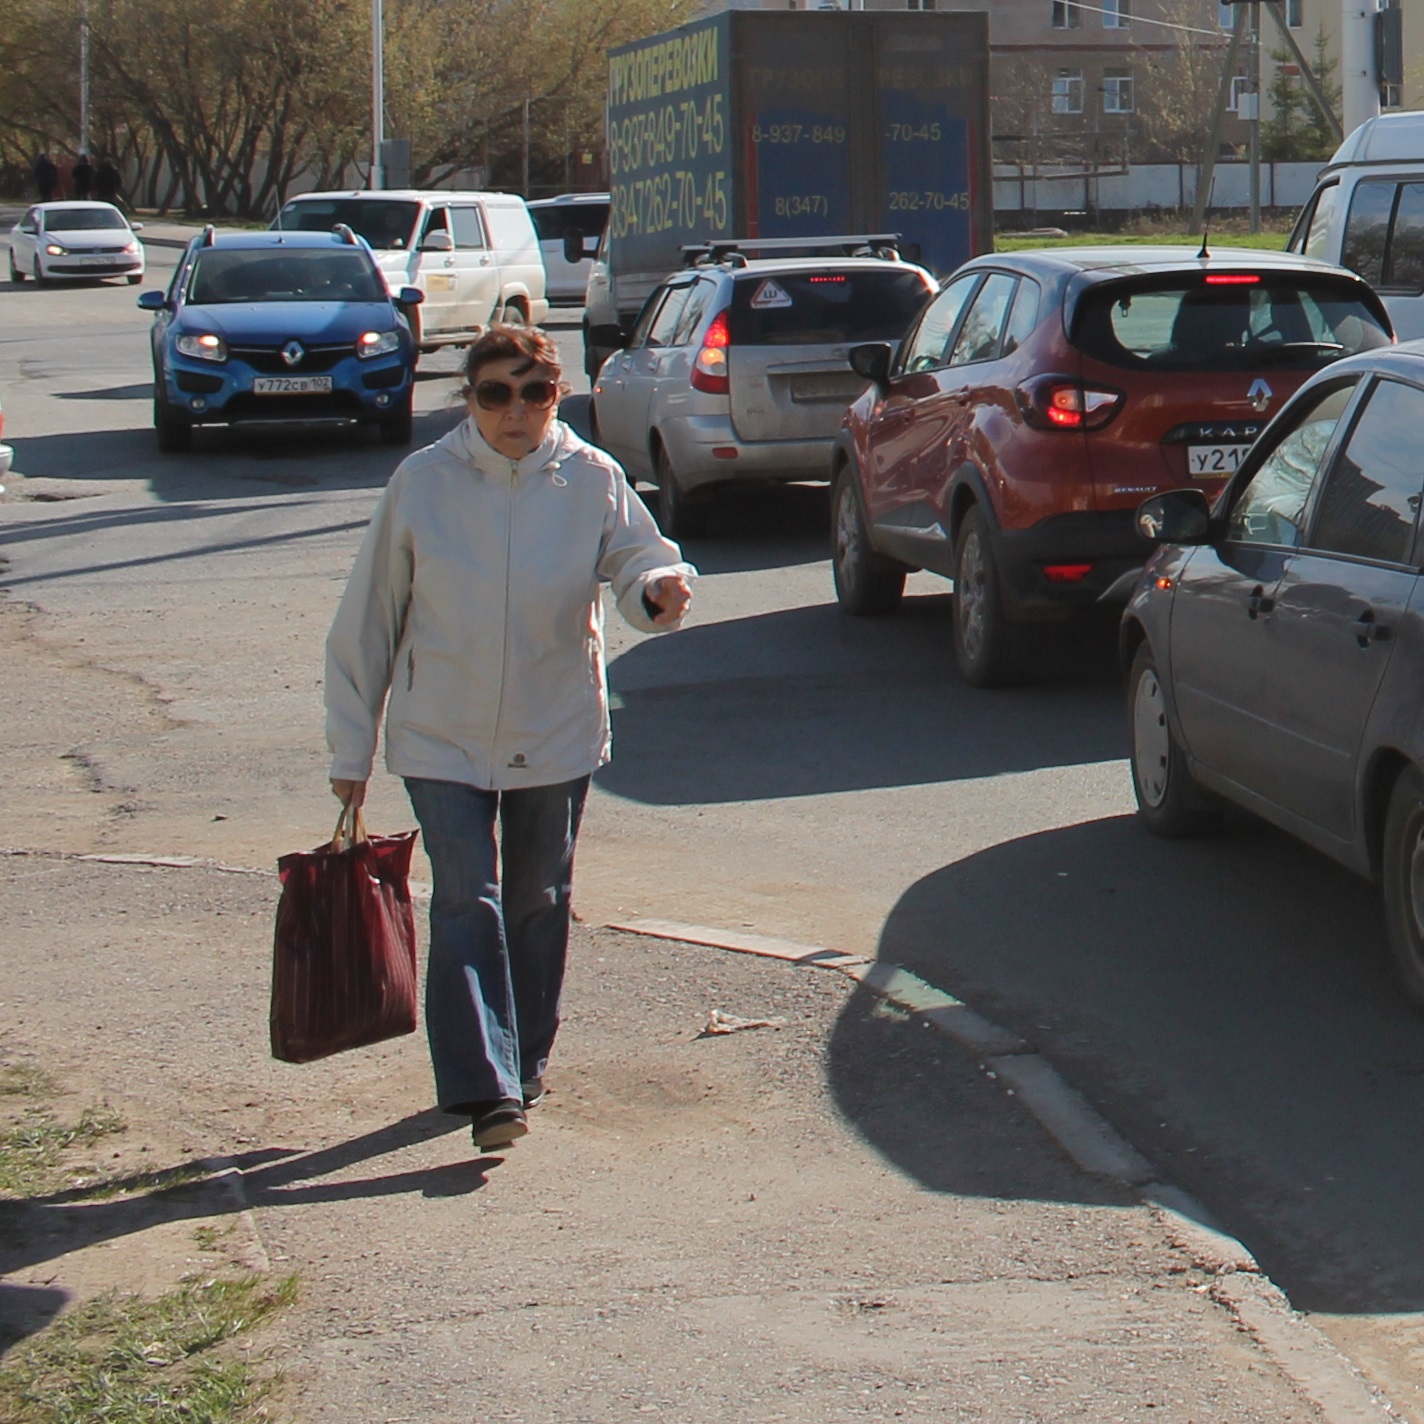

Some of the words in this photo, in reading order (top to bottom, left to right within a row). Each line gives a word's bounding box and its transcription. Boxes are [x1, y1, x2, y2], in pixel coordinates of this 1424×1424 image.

[608, 26, 718, 107] ГРУЗОПЕРЕВОЗКИ
[610, 94, 724, 174] 8-937-849-70-45
[751, 125, 846, 143] 8-937-849
[775, 195, 828, 217] 8(347)
[888, 192, 970, 210] 262-70-45
[764, 289, 777, 299] Ш
[311, 378, 329, 388] 102
